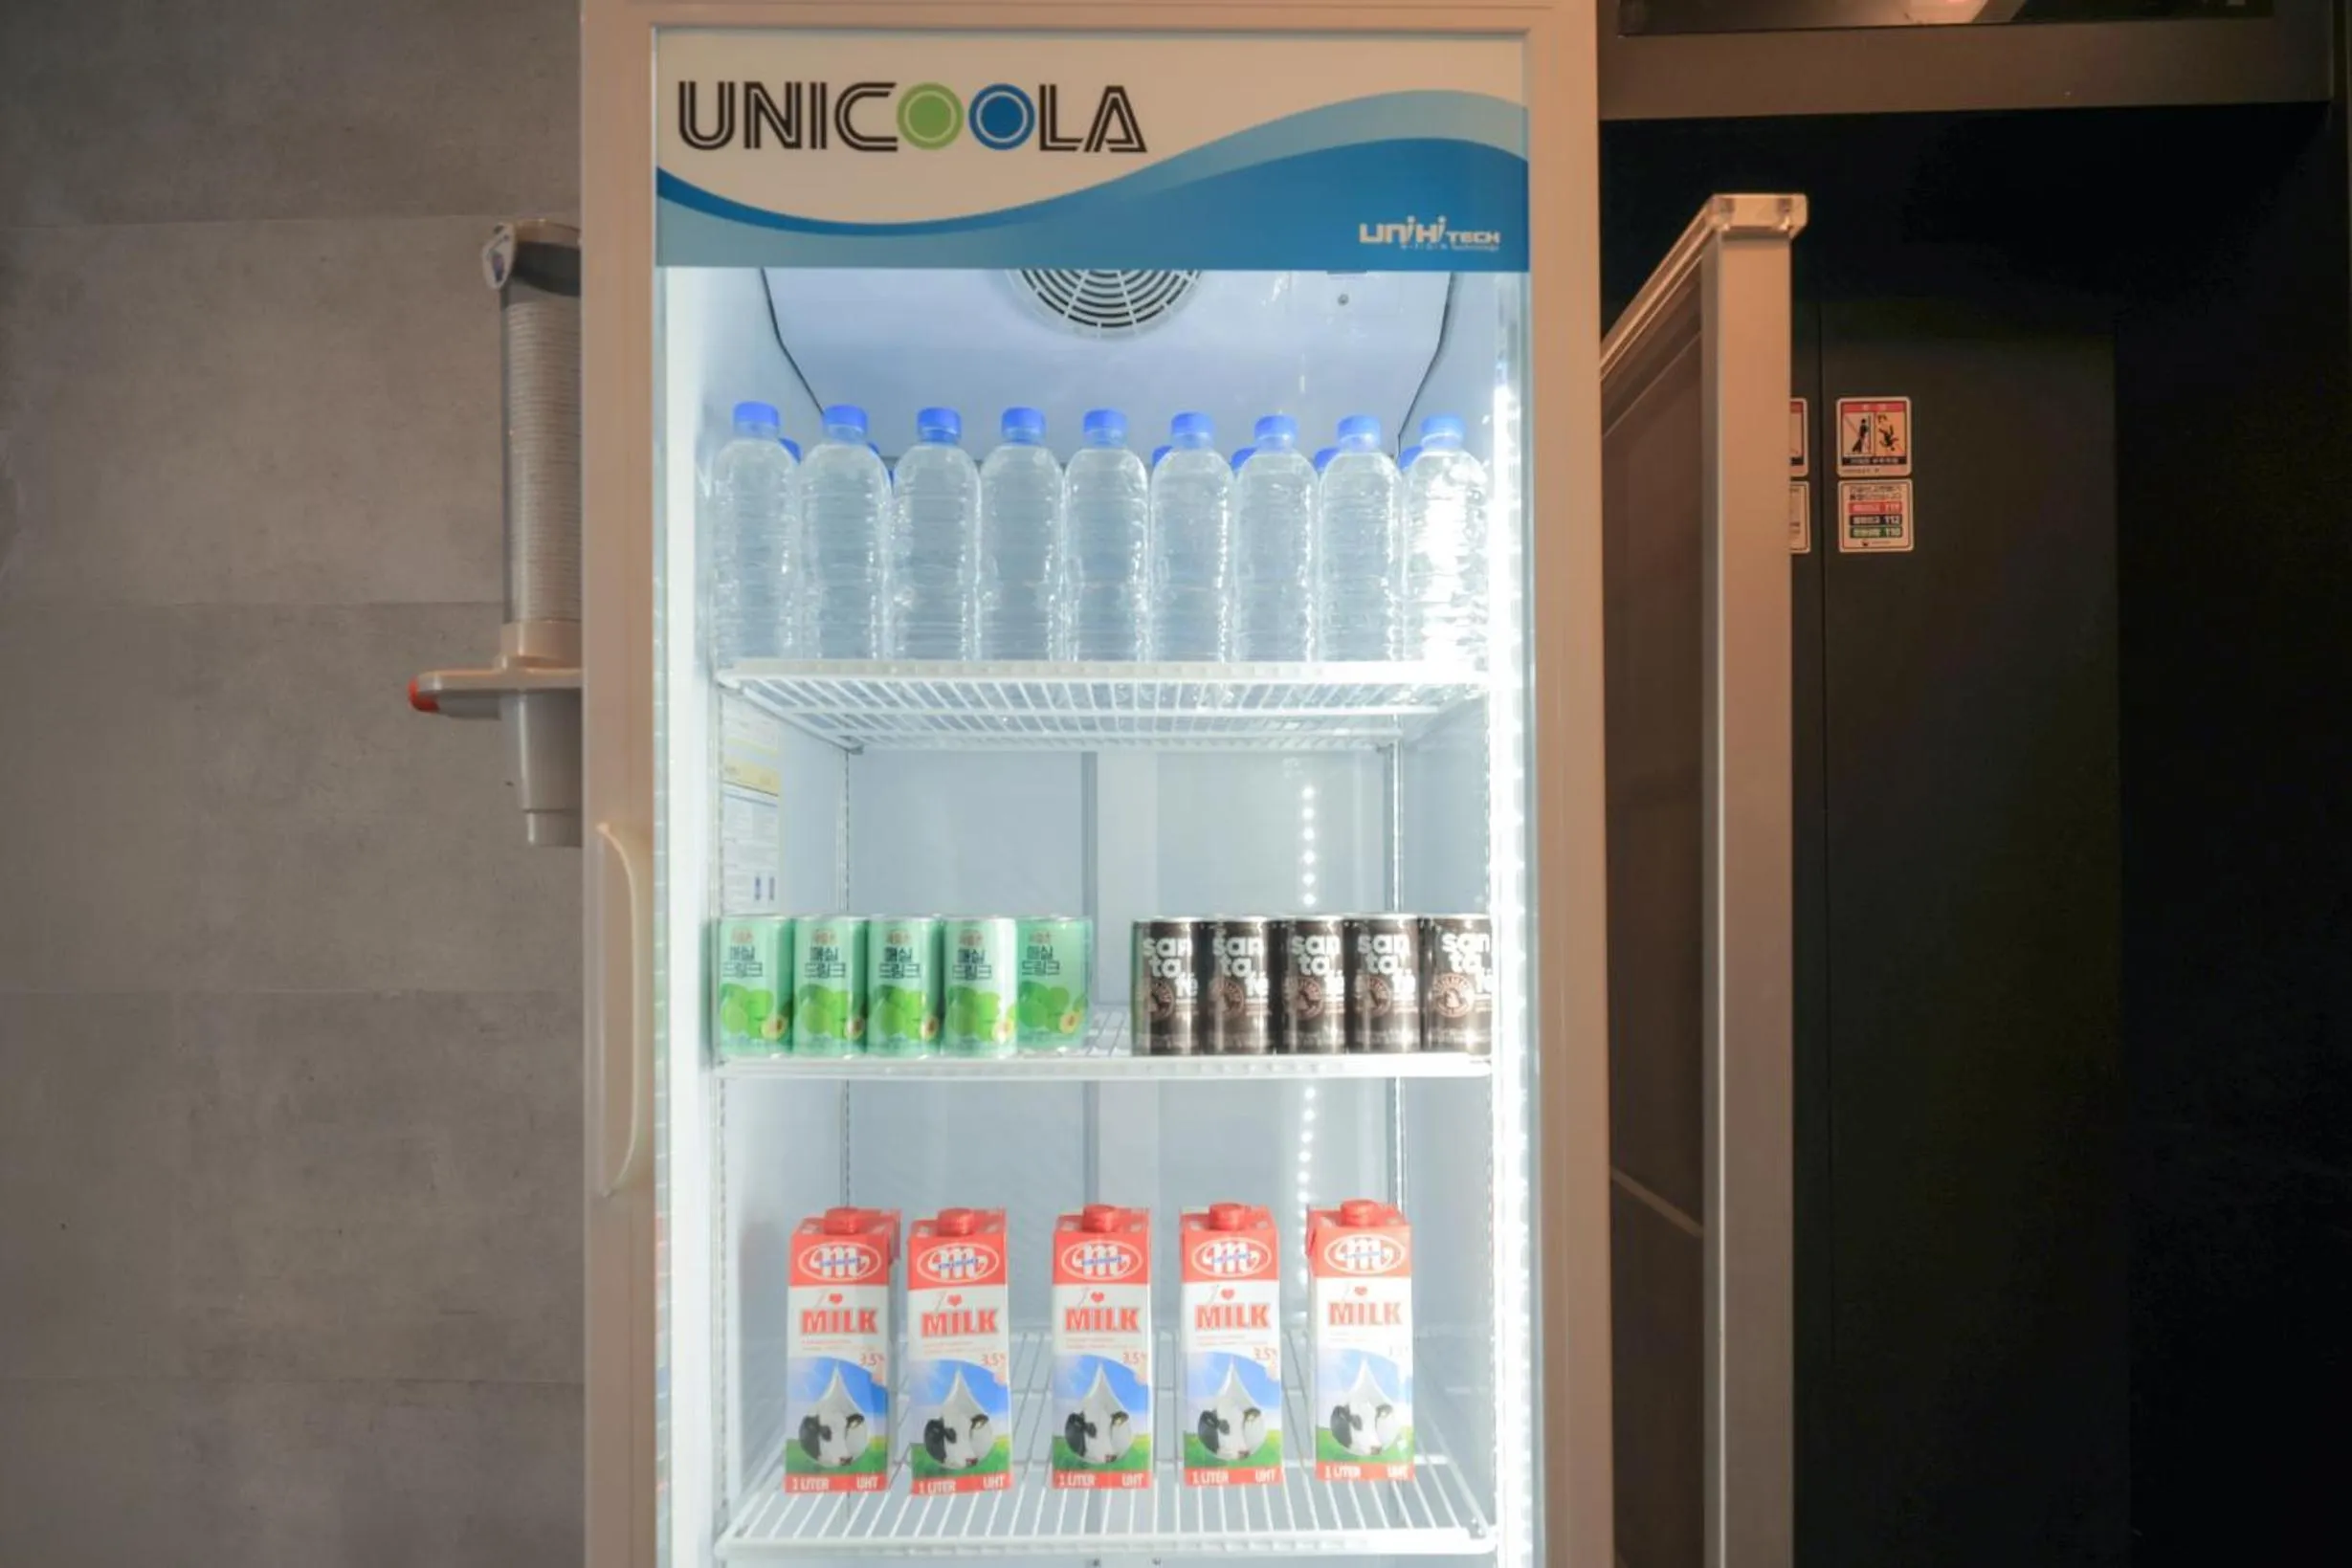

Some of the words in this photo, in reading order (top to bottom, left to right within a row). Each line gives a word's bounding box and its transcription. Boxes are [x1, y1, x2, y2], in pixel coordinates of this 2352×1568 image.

[677, 80, 1148, 153] UNICOOLA
[722, 962, 764, 978] 드링크
[805, 962, 847, 979] 드링크
[879, 963, 921, 979] 드링크
[952, 963, 992, 980] 드링크
[1022, 961, 1060, 976] 드링크
[1065, 1308, 1141, 1333] MILK
[1195, 1303, 1271, 1331] MILK
[1328, 1301, 1402, 1326] MILK
[801, 1310, 878, 1336] MILK
[921, 1310, 997, 1337] MILK
[800, 1476, 830, 1490] LITER
[855, 1474, 878, 1489] UHT
[983, 1474, 1005, 1489] UHT
[1201, 1469, 1229, 1484] LITER
[927, 1479, 956, 1493] LITER
